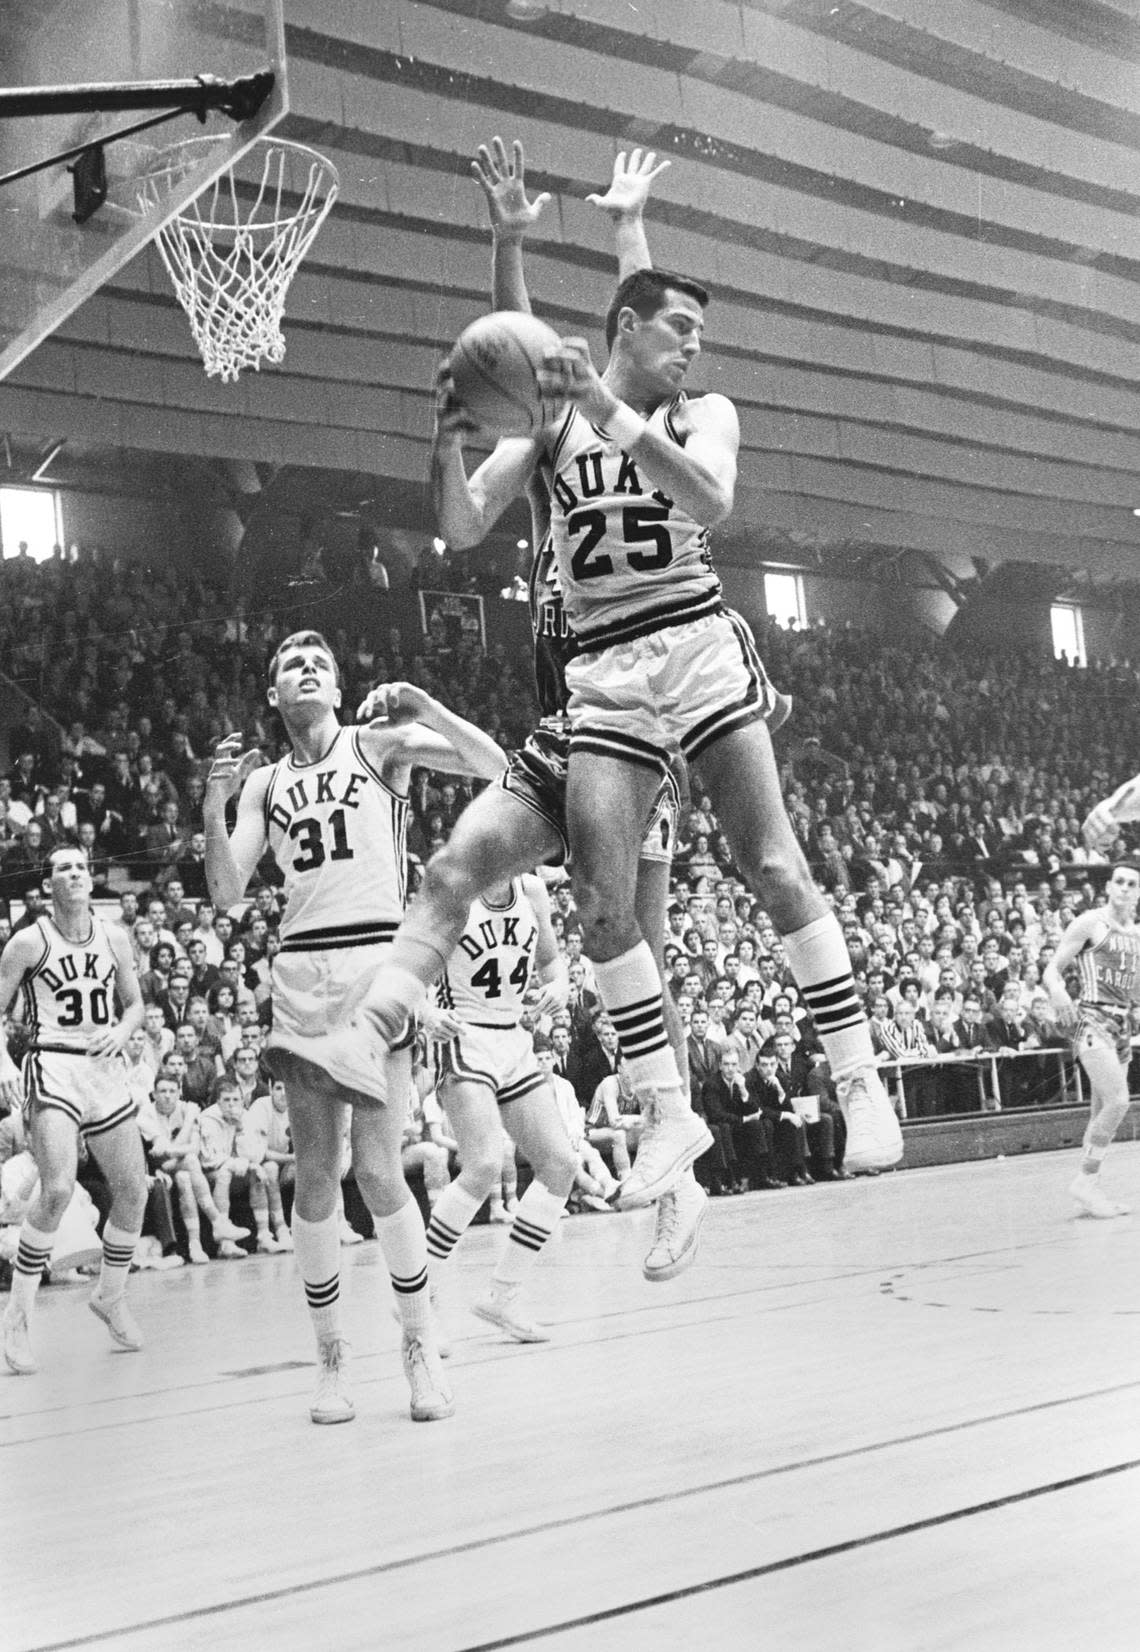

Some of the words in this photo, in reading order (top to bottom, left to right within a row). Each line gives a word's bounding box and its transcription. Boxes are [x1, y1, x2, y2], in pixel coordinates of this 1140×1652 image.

[554, 450, 675, 516] DUK
[568, 506, 673, 581] 25
[268, 770, 368, 833] DUKE
[289, 809, 354, 873] 31
[55, 988, 110, 1027] 30
[470, 956, 530, 999] 44
